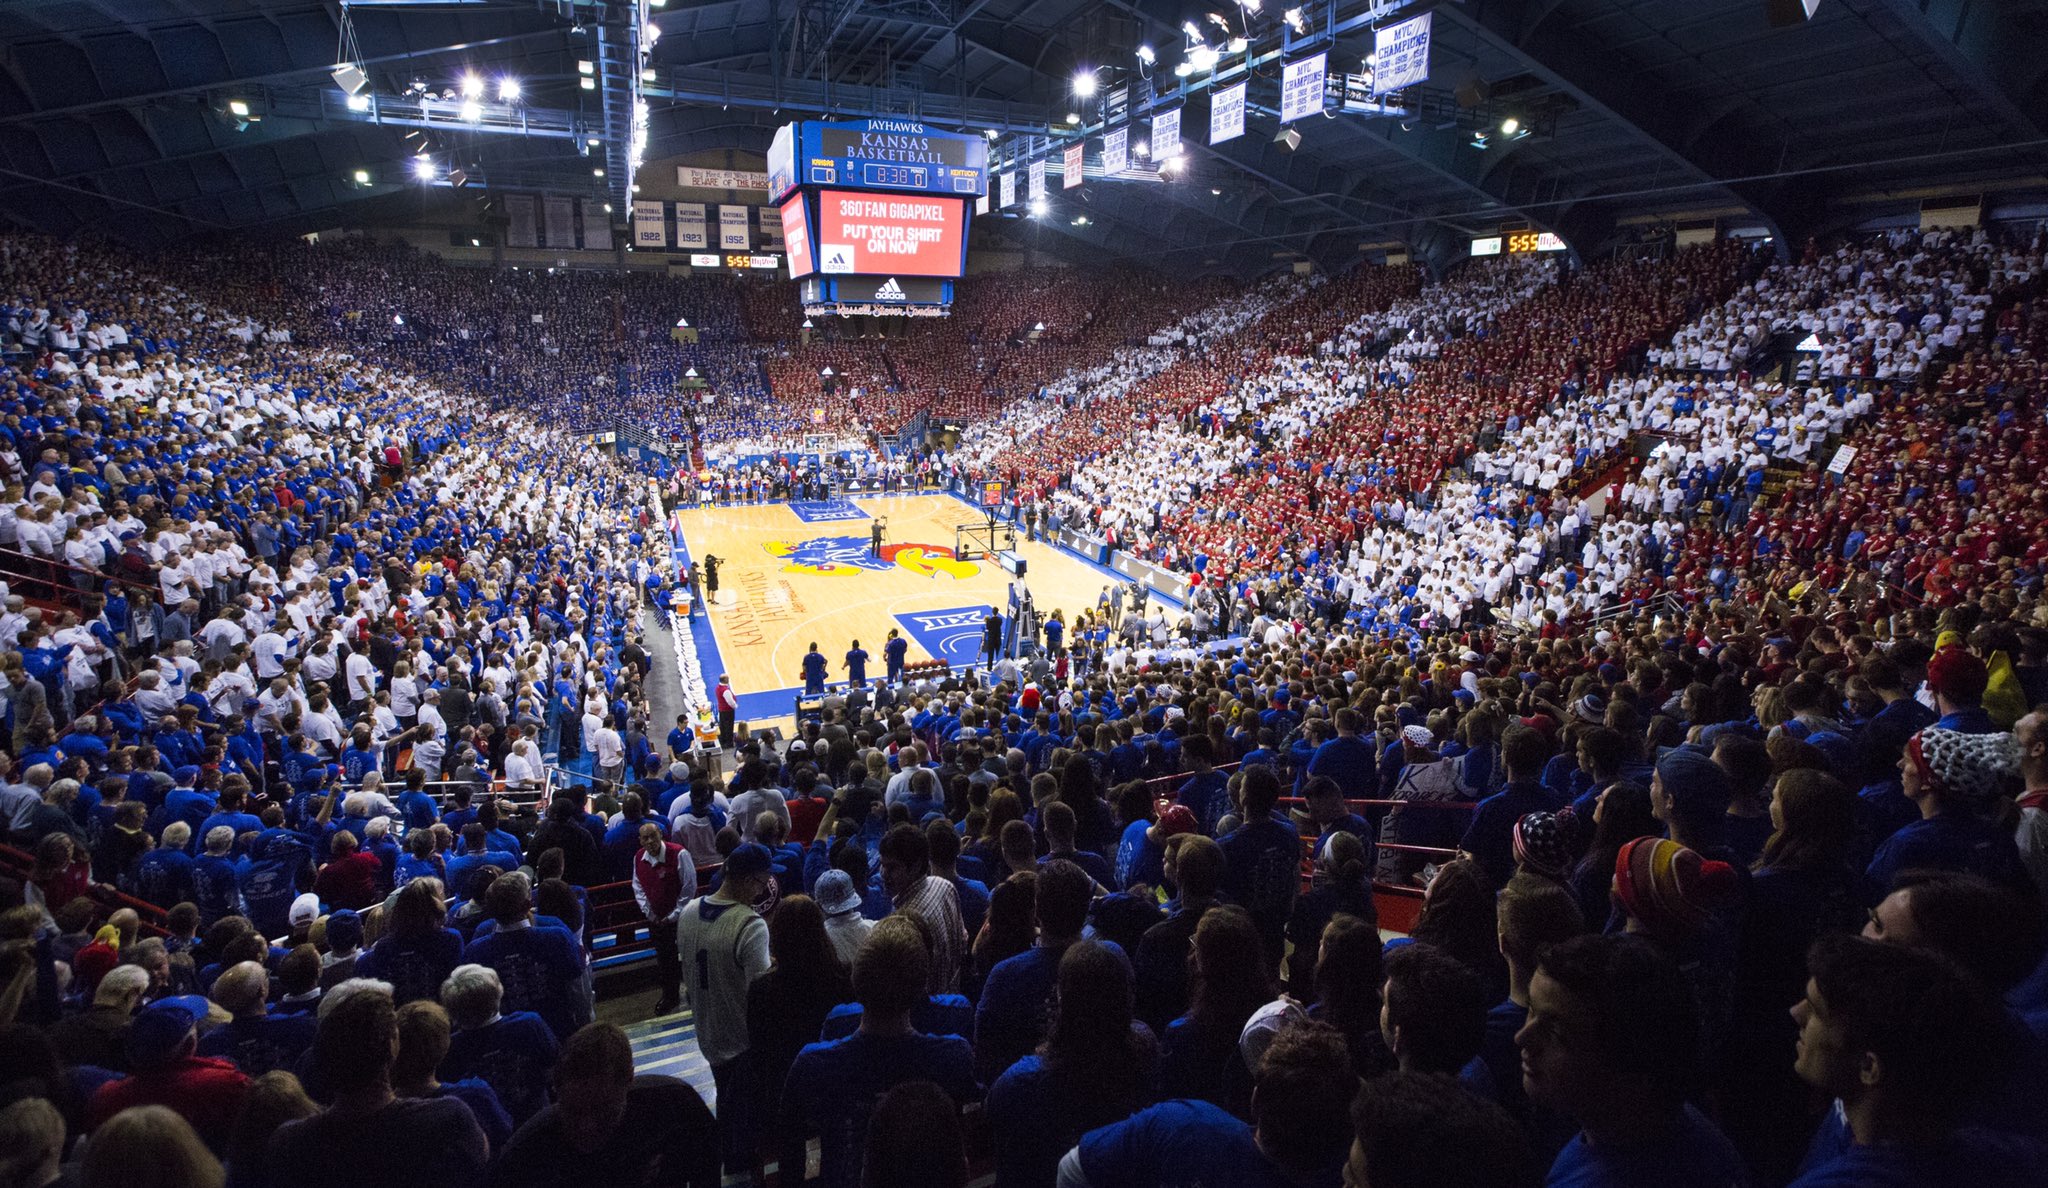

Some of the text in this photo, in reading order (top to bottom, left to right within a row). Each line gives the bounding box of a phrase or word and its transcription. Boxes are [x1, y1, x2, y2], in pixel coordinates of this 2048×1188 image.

[1394, 24, 1413, 41] MVC
[1379, 32, 1427, 60] CHAMPIONS
[1297, 62, 1312, 76] MVC
[1285, 70, 1323, 91] CHAMPIONS
[1213, 97, 1243, 117] CHAMPIONS
[868, 120, 923, 133] JAYHAWKS
[862, 133, 928, 150] KANSAS
[847, 146, 944, 164] BASKETBALL
[812, 159, 834, 167] KANSAS
[826, 169, 835, 182] 0
[878, 167, 907, 184] 8:38
[914, 173, 922, 187] 0
[950, 169, 978, 177] KENTUCKY
[692, 177, 718, 186] BEWARE
[723, 179, 732, 187] OF
[865, 202, 886, 218] FAN
[889, 203, 944, 221] GIGAPIXEL
[640, 232, 660, 240] 1922
[683, 233, 702, 242] 1923
[725, 235, 744, 244] 1952
[843, 224, 942, 242] PUT YOUR SHIRT
[867, 240, 918, 254] ON NOW
[1510, 234, 1538, 252] 5:55
[727, 256, 750, 267] 5:55
[875, 291, 905, 300] adidas
[836, 302, 871, 318] Russell
[872, 302, 905, 317] Stover
[906, 303, 940, 317] Candies
[722, 601, 766, 648] KANSAS
[696, 948, 708, 990] 1
